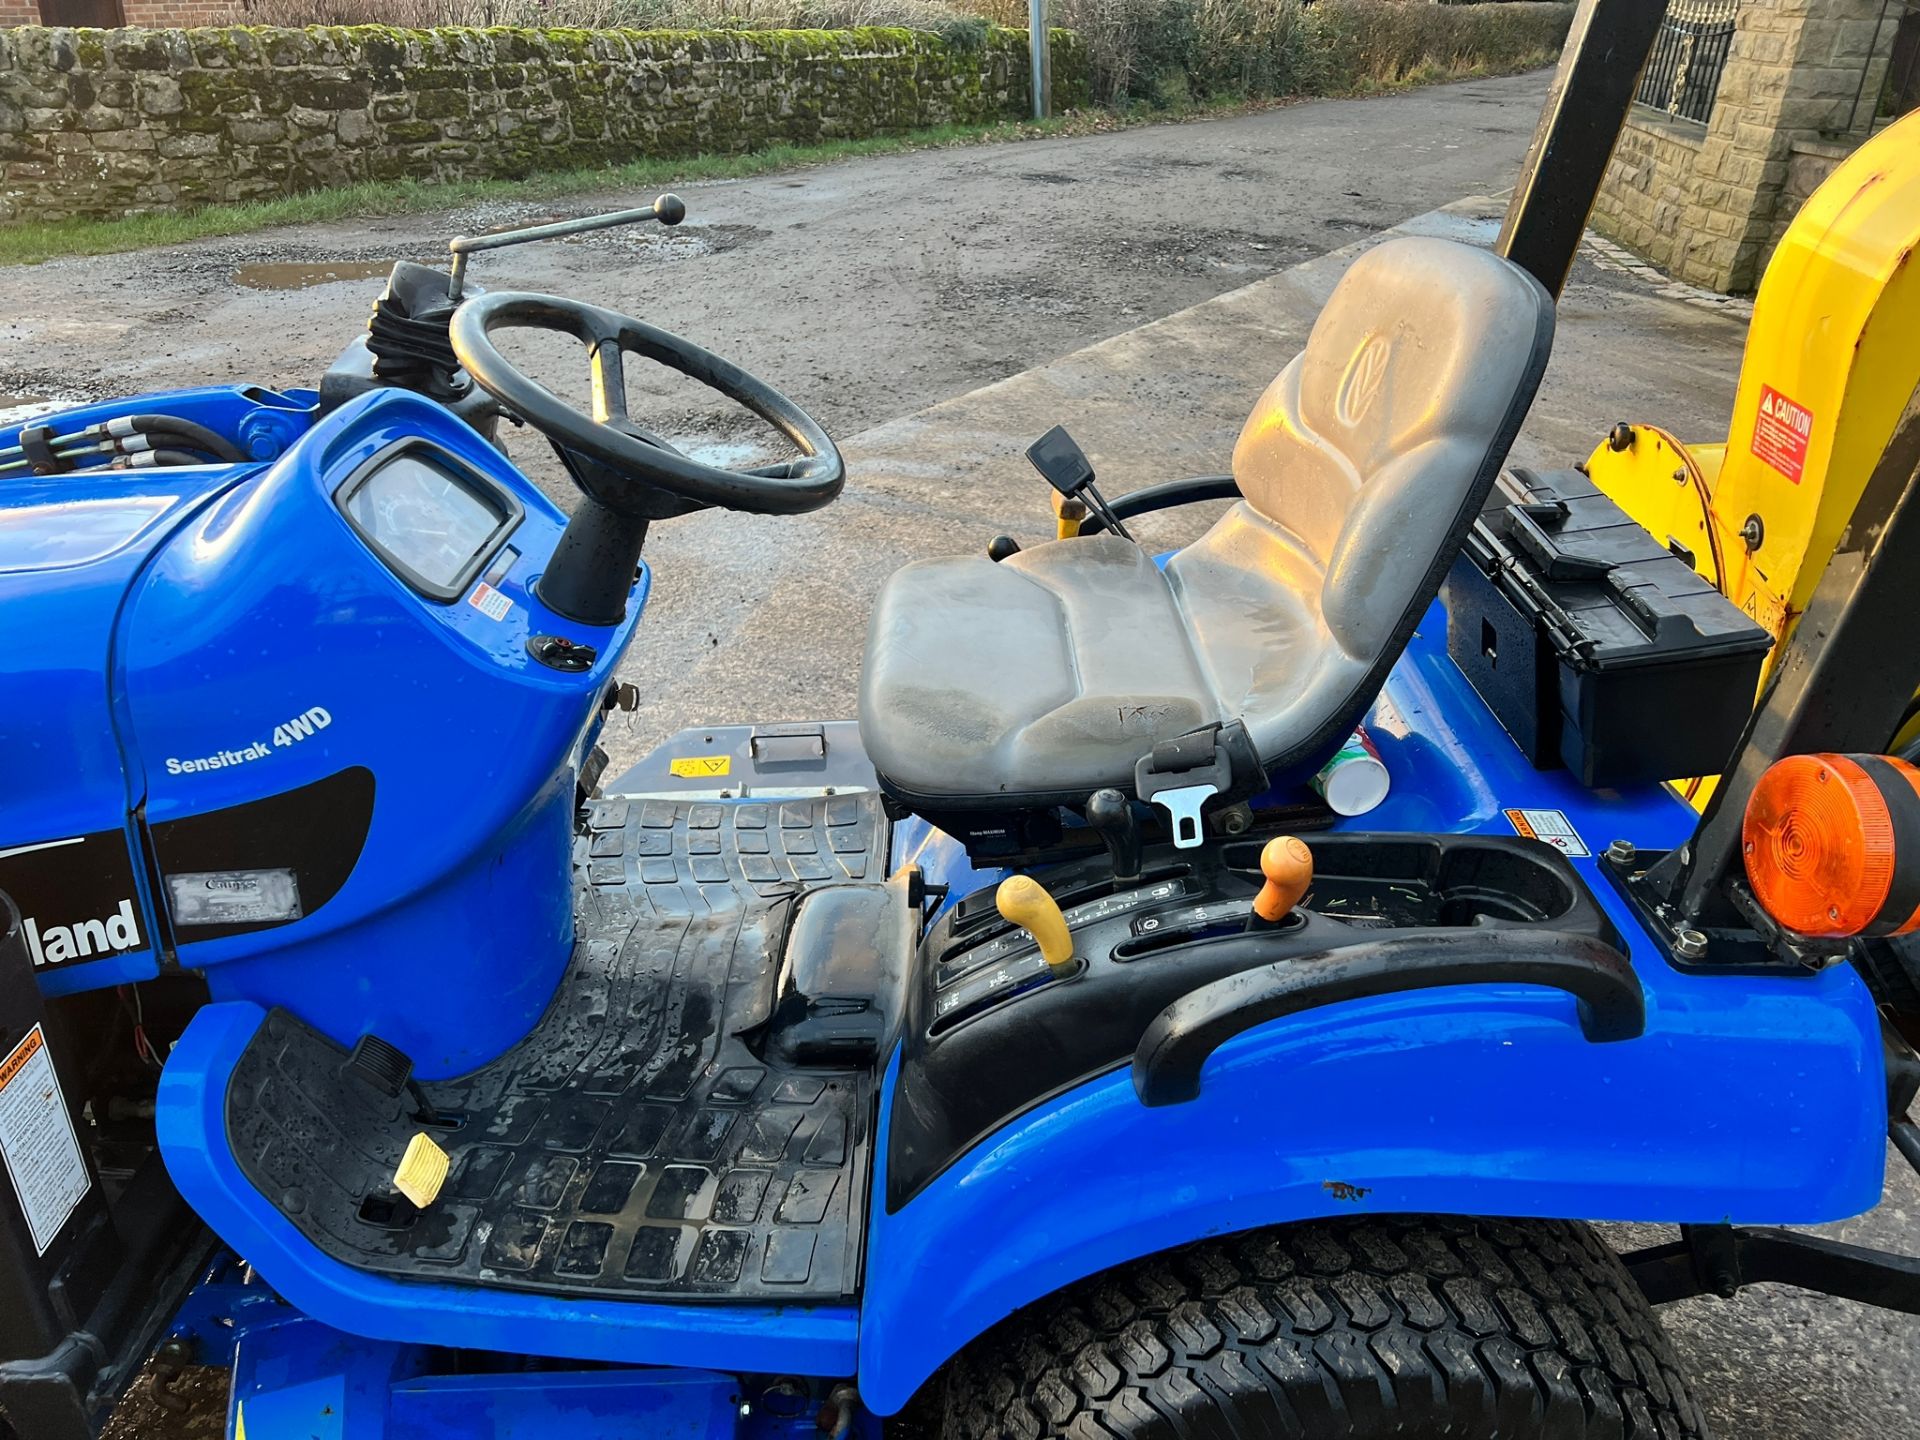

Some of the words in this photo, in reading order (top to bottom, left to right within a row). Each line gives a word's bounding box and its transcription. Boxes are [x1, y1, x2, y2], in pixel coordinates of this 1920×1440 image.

[1775, 398, 1811, 437] CAUTION
[165, 741, 272, 775] Sensitrak
[272, 706, 333, 748] 4WD
[23, 899, 140, 966] land
[0, 1038, 37, 1083] WARNING
